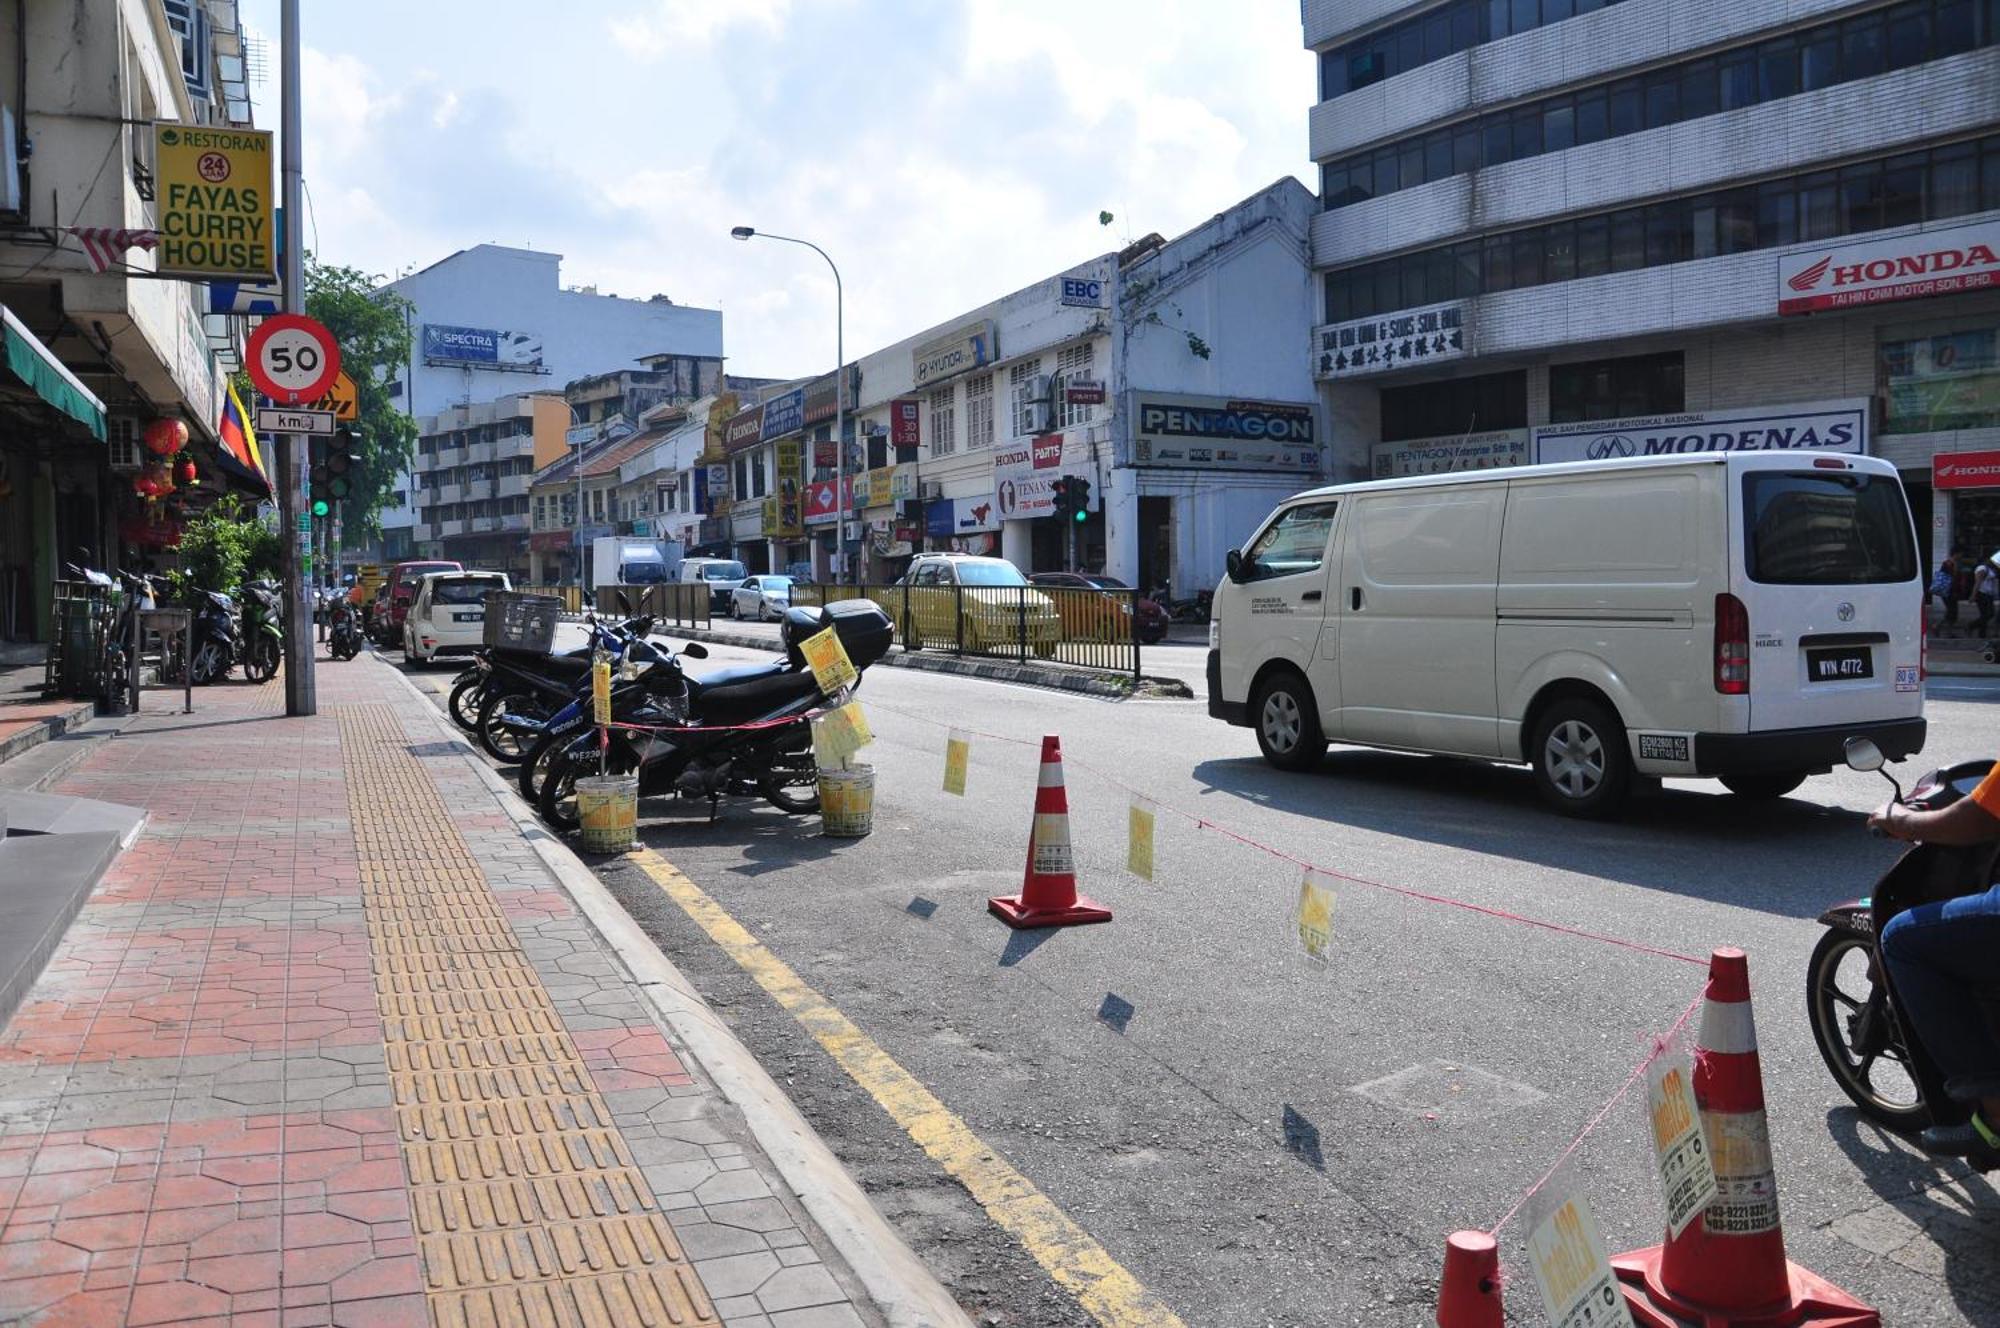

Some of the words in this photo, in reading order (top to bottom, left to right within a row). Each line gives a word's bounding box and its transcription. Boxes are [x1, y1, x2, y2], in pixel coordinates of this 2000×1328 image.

[184, 132, 266, 151] RESTORAN
[204, 156, 225, 170] 24
[203, 168, 225, 178] JAM
[169, 184, 259, 214] FAYAS
[164, 211, 263, 240] CURRY
[164, 239, 265, 268] HOUSE
[1832, 245, 2000, 287] HONDA
[1064, 280, 1099, 299] EBC
[1895, 281, 1934, 298] MOTOR
[444, 332, 493, 347] SPECTRA
[270, 346, 318, 373] 50
[928, 350, 963, 375] HYUNDAI
[278, 414, 314, 430] kmj
[732, 419, 760, 441] HONDA
[1146, 409, 1311, 439] PENTAGON
[1644, 423, 1854, 456] MODENAS
[996, 450, 1030, 467] HONDA
[1034, 445, 1061, 460] PARTS
[1819, 660, 1839, 676] WYN
[1840, 659, 1863, 674] 4772
